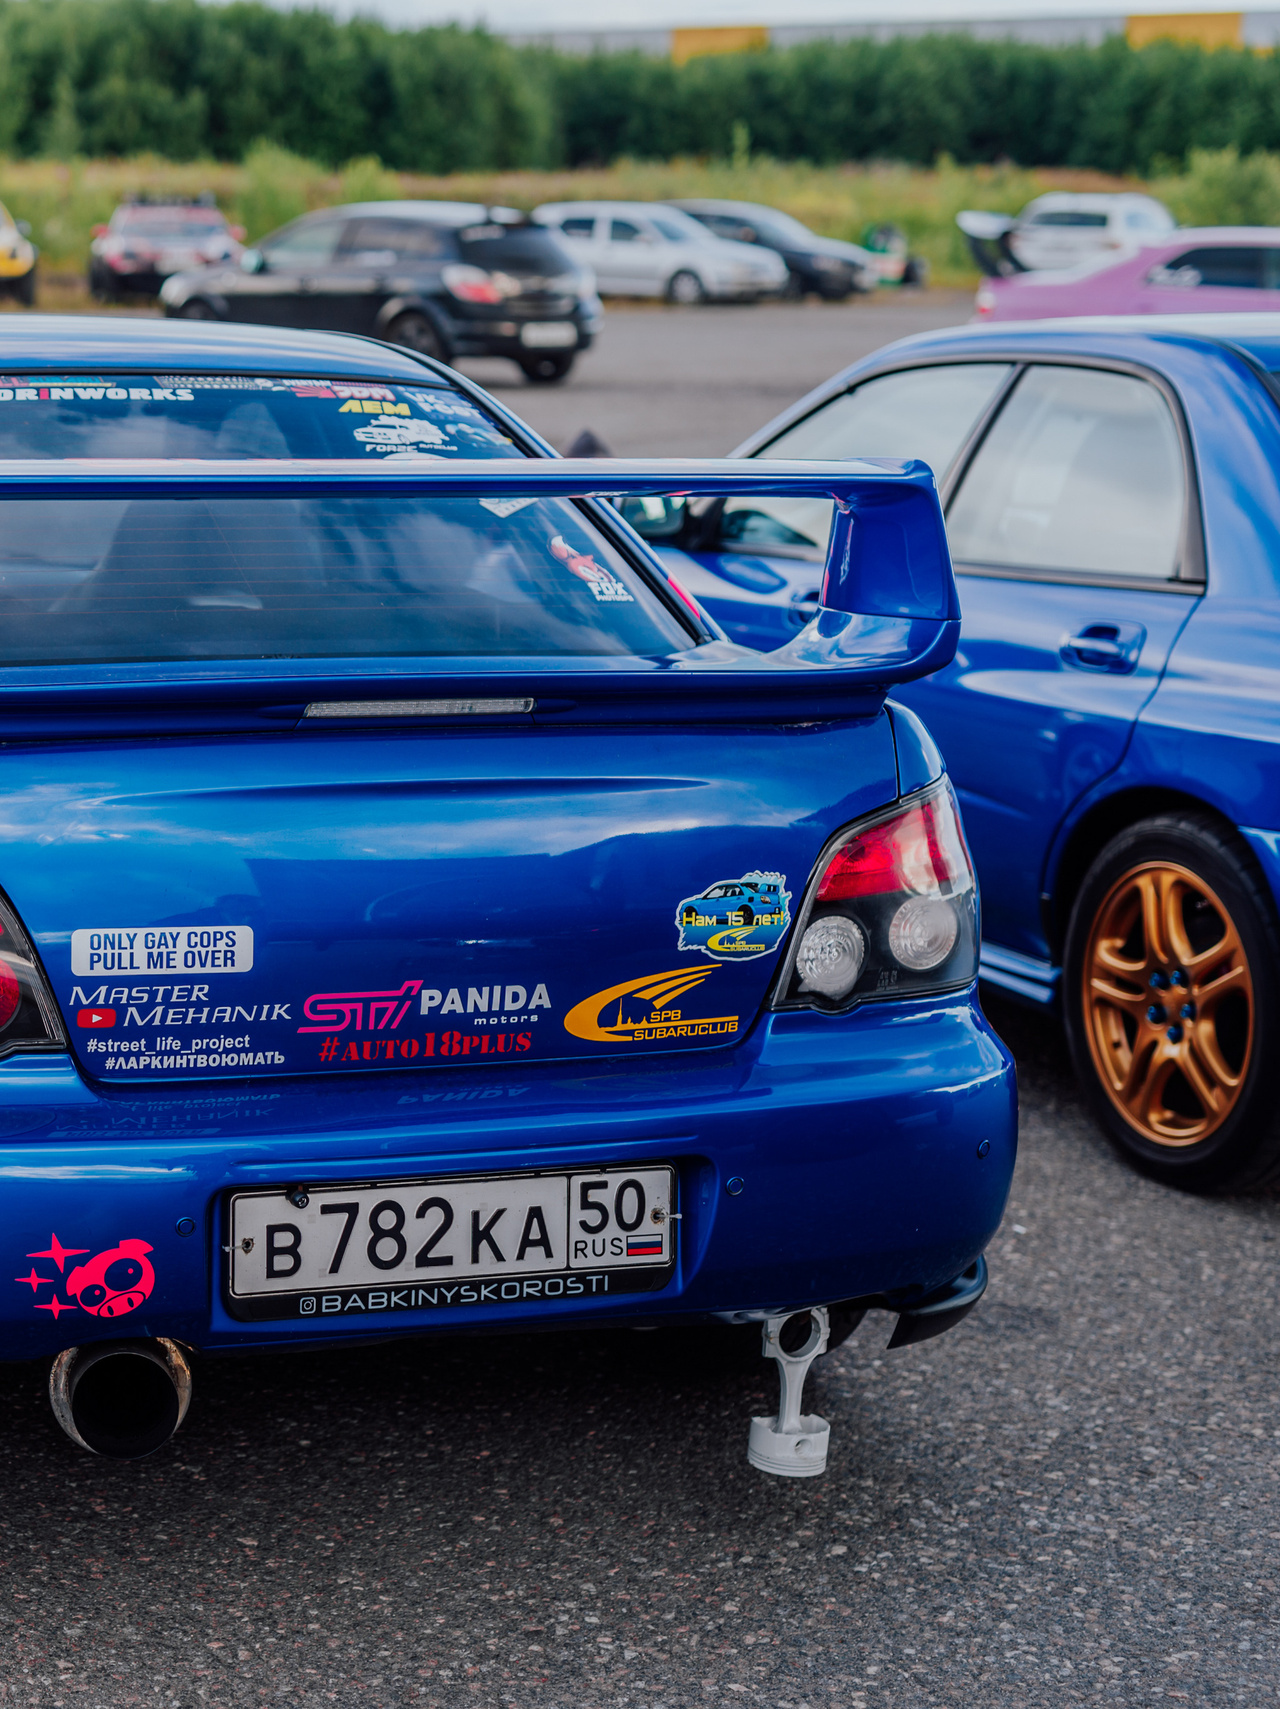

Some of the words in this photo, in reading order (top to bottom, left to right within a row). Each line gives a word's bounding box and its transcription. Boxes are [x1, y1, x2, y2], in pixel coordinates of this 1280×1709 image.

[338, 400, 411, 415] AEM
[587, 581, 628, 595] FOX
[683, 911, 717, 927] Нам
[726, 911, 744, 926] 15
[753, 911, 784, 926] лет!
[90, 932, 138, 950] ONLY
[144, 932, 181, 949] GAY
[187, 930, 236, 948] COPS
[90, 951, 140, 970] PULL
[147, 951, 177, 969] ME
[184, 950, 236, 968] OVER
[69, 984, 209, 1006] MASTER
[420, 983, 552, 1015] PANIDA
[123, 1004, 292, 1027] MEHANIK
[474, 1014, 539, 1026] motors
[650, 1010, 681, 1022] SPB
[634, 1021, 739, 1041] SUBARUCLUB
[87, 1034, 250, 1055] #street_life_project
[319, 1031, 532, 1062] #AUTO18PLUS
[105, 1051, 285, 1070] #ЛАРКИНТВОЮМАТЬ
[578, 1178, 646, 1234] 50
[574, 1238, 624, 1259] RUS
[321, 1275, 609, 1313] BABKINYSKOROSTI
